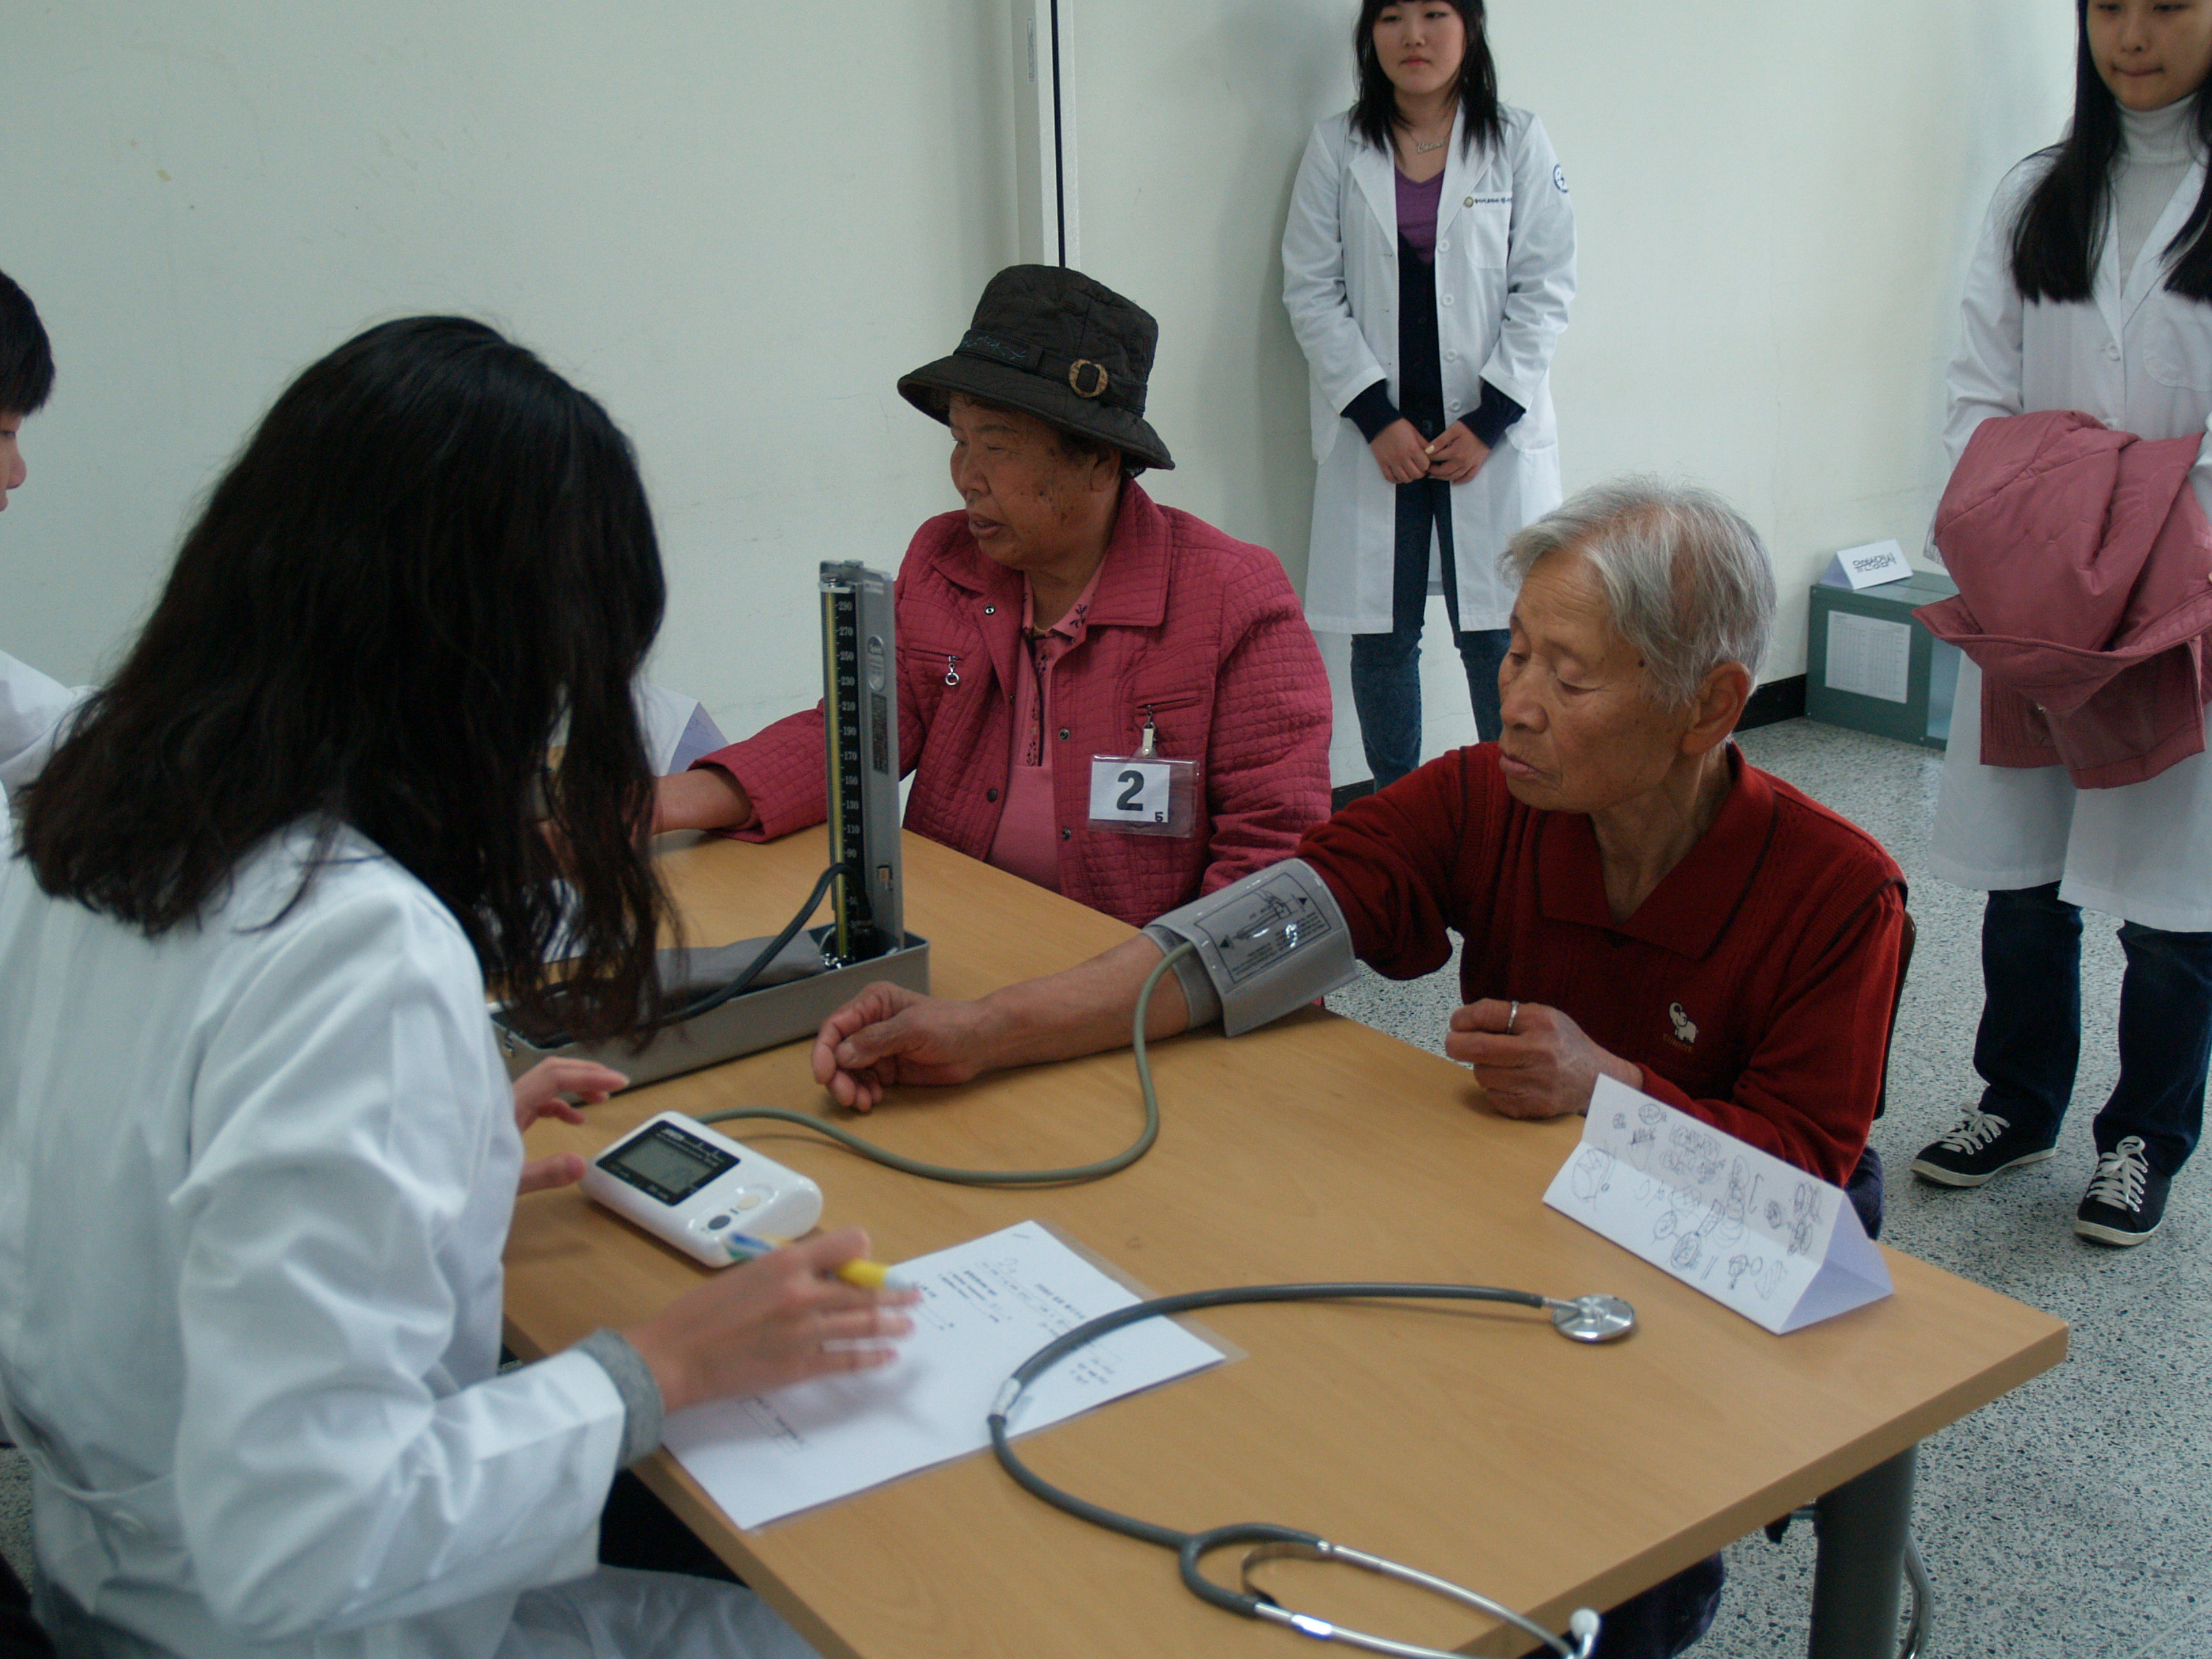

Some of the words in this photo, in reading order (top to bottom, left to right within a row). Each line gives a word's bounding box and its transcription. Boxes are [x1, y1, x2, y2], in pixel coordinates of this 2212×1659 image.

[838, 601, 853, 611] 290
[839, 626, 853, 636] 270
[840, 651, 855, 661] 250
[840, 676, 855, 686] 230
[841, 701, 855, 711] 210
[842, 726, 857, 735] 190
[844, 752, 857, 760] 170
[845, 776, 858, 785] 150
[1116, 770, 1144, 811] 2
[846, 800, 859, 810] 130
[847, 825, 860, 834] 110
